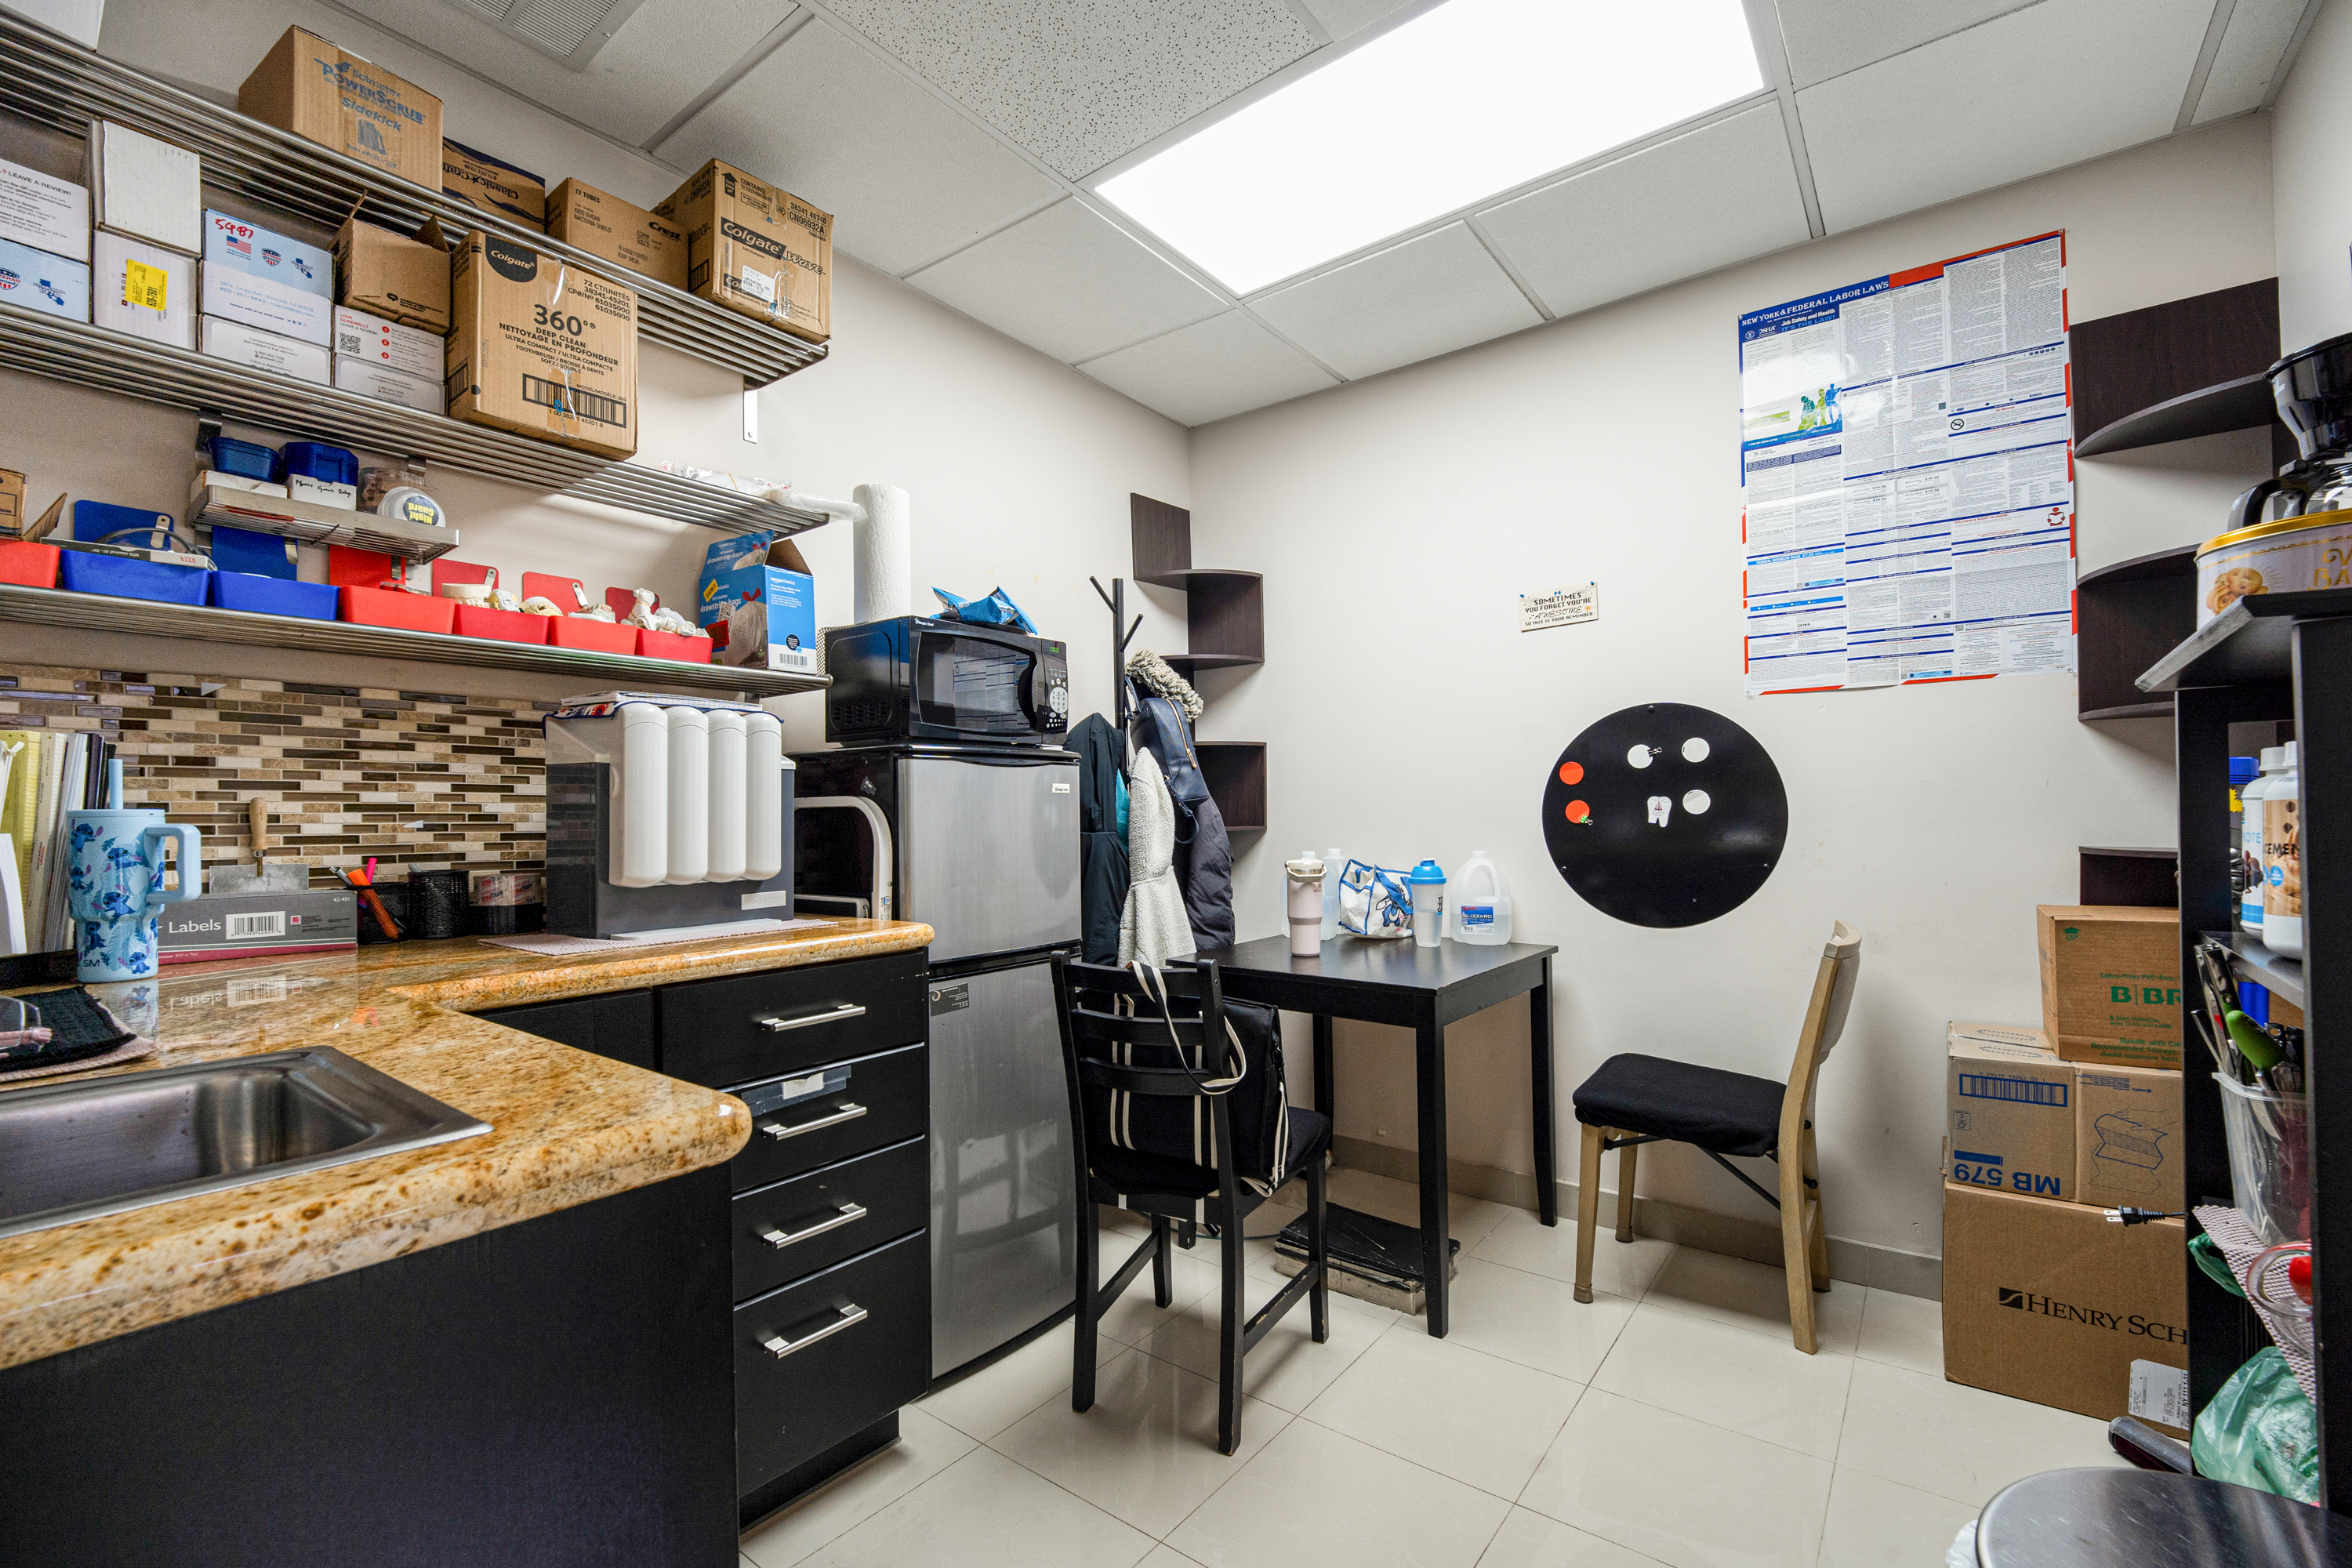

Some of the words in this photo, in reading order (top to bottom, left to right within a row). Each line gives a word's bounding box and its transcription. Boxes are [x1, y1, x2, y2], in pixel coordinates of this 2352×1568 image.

[341, 96, 401, 132] Sidekick
[9, 172, 32, 183] LEAVE
[41, 183, 71, 195] REVIEW!
[583, 191, 600, 203] TUBES
[574, 208, 585, 216] KIDS
[585, 211, 601, 223] SUGAR
[574, 214, 595, 227] BACTERIA
[596, 221, 612, 234] SHIELD
[648, 221, 681, 241] Crest
[724, 223, 778, 254] Colgate
[491, 249, 532, 270] Colgate
[39, 287, 60, 298] 1970
[585, 286, 630, 308] 38341-45201
[594, 283, 630, 301] CT/UNITÉS
[596, 298, 630, 315] 61035000
[596, 304, 630, 321] 61035000
[1742, 317, 1758, 326] NEW
[1759, 310, 1780, 321] YORK
[1787, 298, 1828, 314] FEDERAL
[1830, 289, 1861, 303] LABOR
[1863, 281, 1889, 294] LAWS
[340, 318, 368, 328] GLIDEWELL?
[1781, 318, 1791, 326] Job
[1791, 314, 1808, 323] Safety
[1818, 308, 1835, 317] Health
[1814, 315, 1835, 324] LAW!
[499, 323, 548, 343] NETTOYAGE
[552, 339, 561, 348] EN
[565, 344, 618, 366] PROFONDEUR
[536, 327, 557, 337] DEEP
[560, 336, 586, 348] CLEAN
[505, 334, 525, 345] ULTRA
[527, 340, 557, 354] COMPACT
[562, 350, 581, 362] ULTRA
[583, 358, 613, 372] COMPACTE
[516, 345, 555, 361] TOOTHBRUSH
[560, 358, 580, 368] BROSSE
[587, 367, 604, 376] DENTS
[408, 502, 434, 516] Guard
[409, 511, 433, 524] Night
[707, 554, 731, 564] drawstring
[700, 601, 723, 612] drawstri
[1534, 593, 1581, 605] SOMETIMES
[1540, 602, 1565, 611] FORGET
[1566, 597, 1592, 606] YOU'RE
[169, 920, 221, 933] Labels
[2111, 986, 2132, 1003] B
[2143, 988, 2181, 1005] BR
[2091, 1043, 2143, 1052] Recommended
[2147, 1047, 2180, 1055] Storage:
[1954, 1163, 2003, 1187] 579
[2013, 1172, 2060, 1196] MB
[2026, 1292, 2123, 1331] HENRY
[2128, 1315, 2188, 1345] SCH
